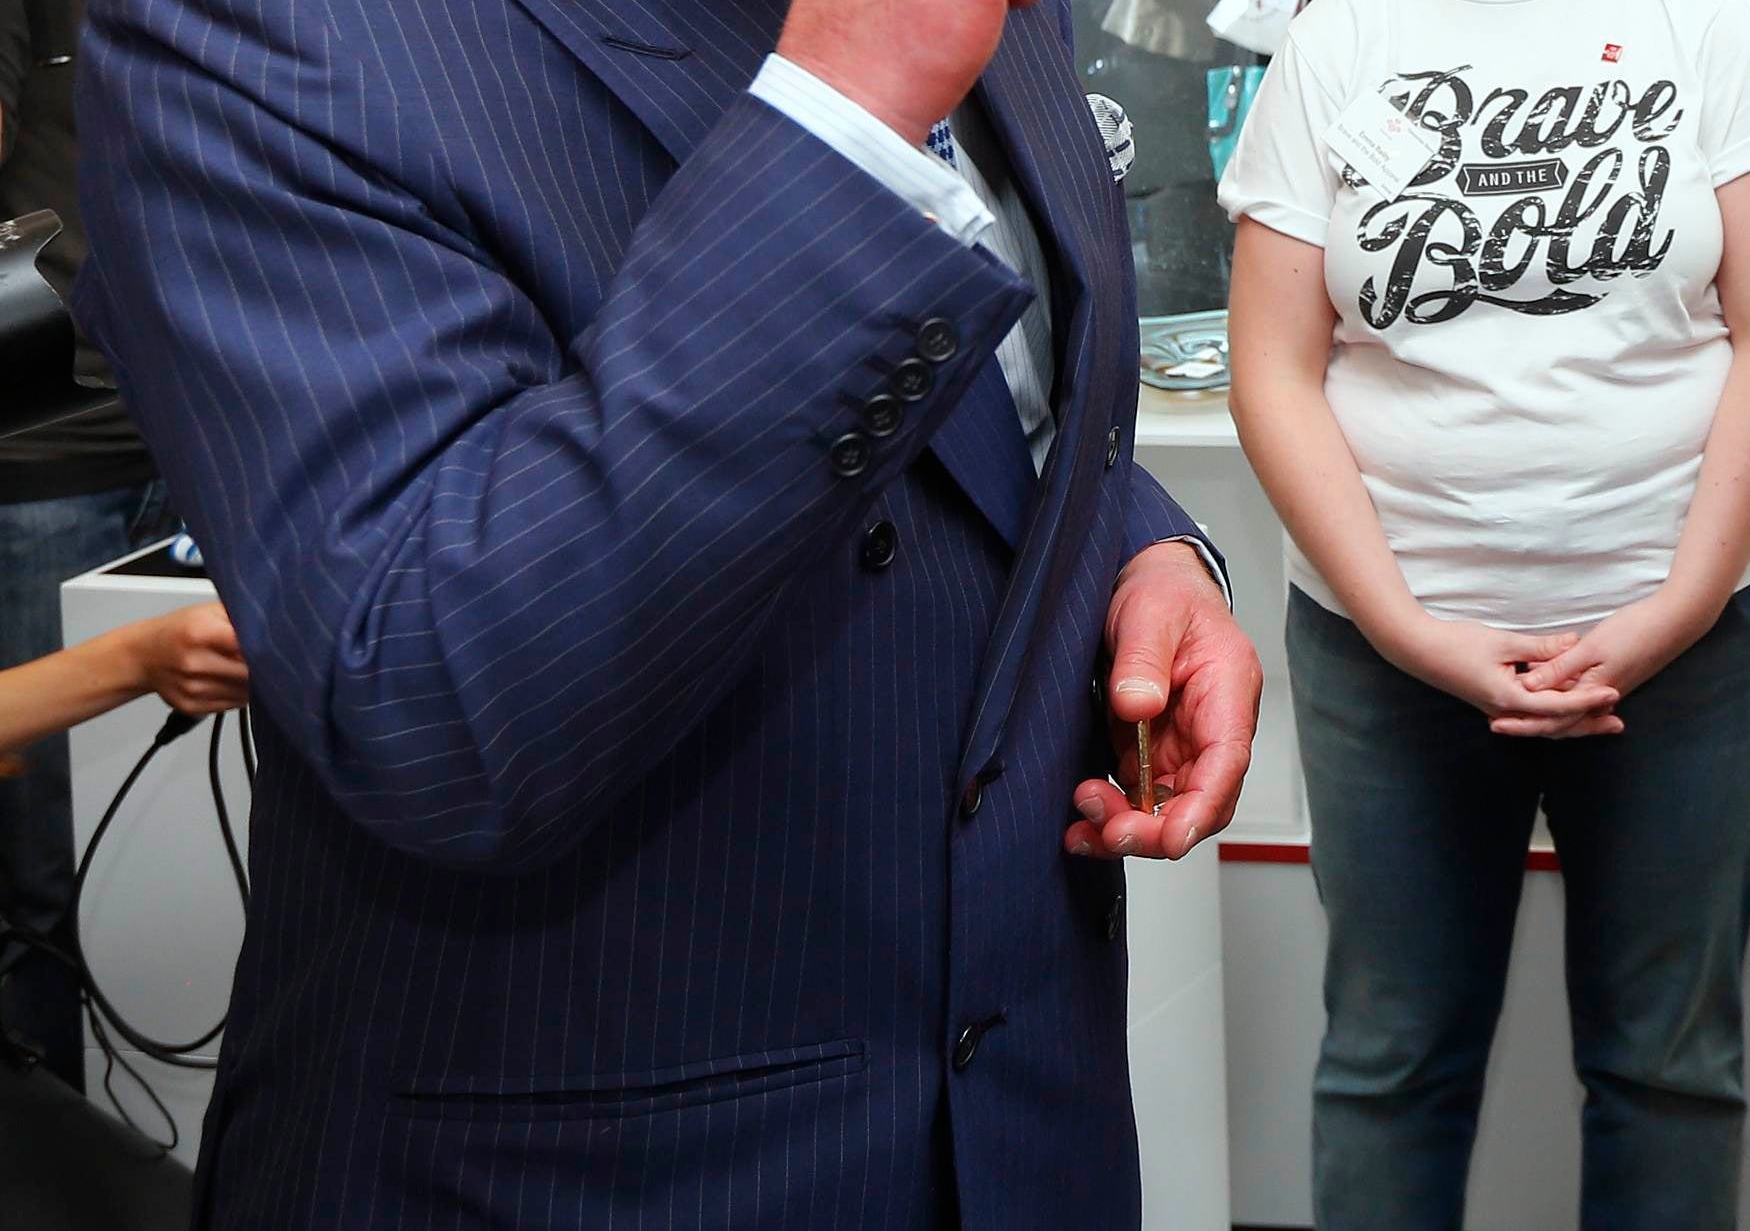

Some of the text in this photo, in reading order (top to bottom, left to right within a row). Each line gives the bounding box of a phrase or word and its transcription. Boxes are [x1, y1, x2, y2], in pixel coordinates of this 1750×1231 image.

[1478, 169, 1549, 188] AND THE
[1356, 145, 1676, 330] Bold
